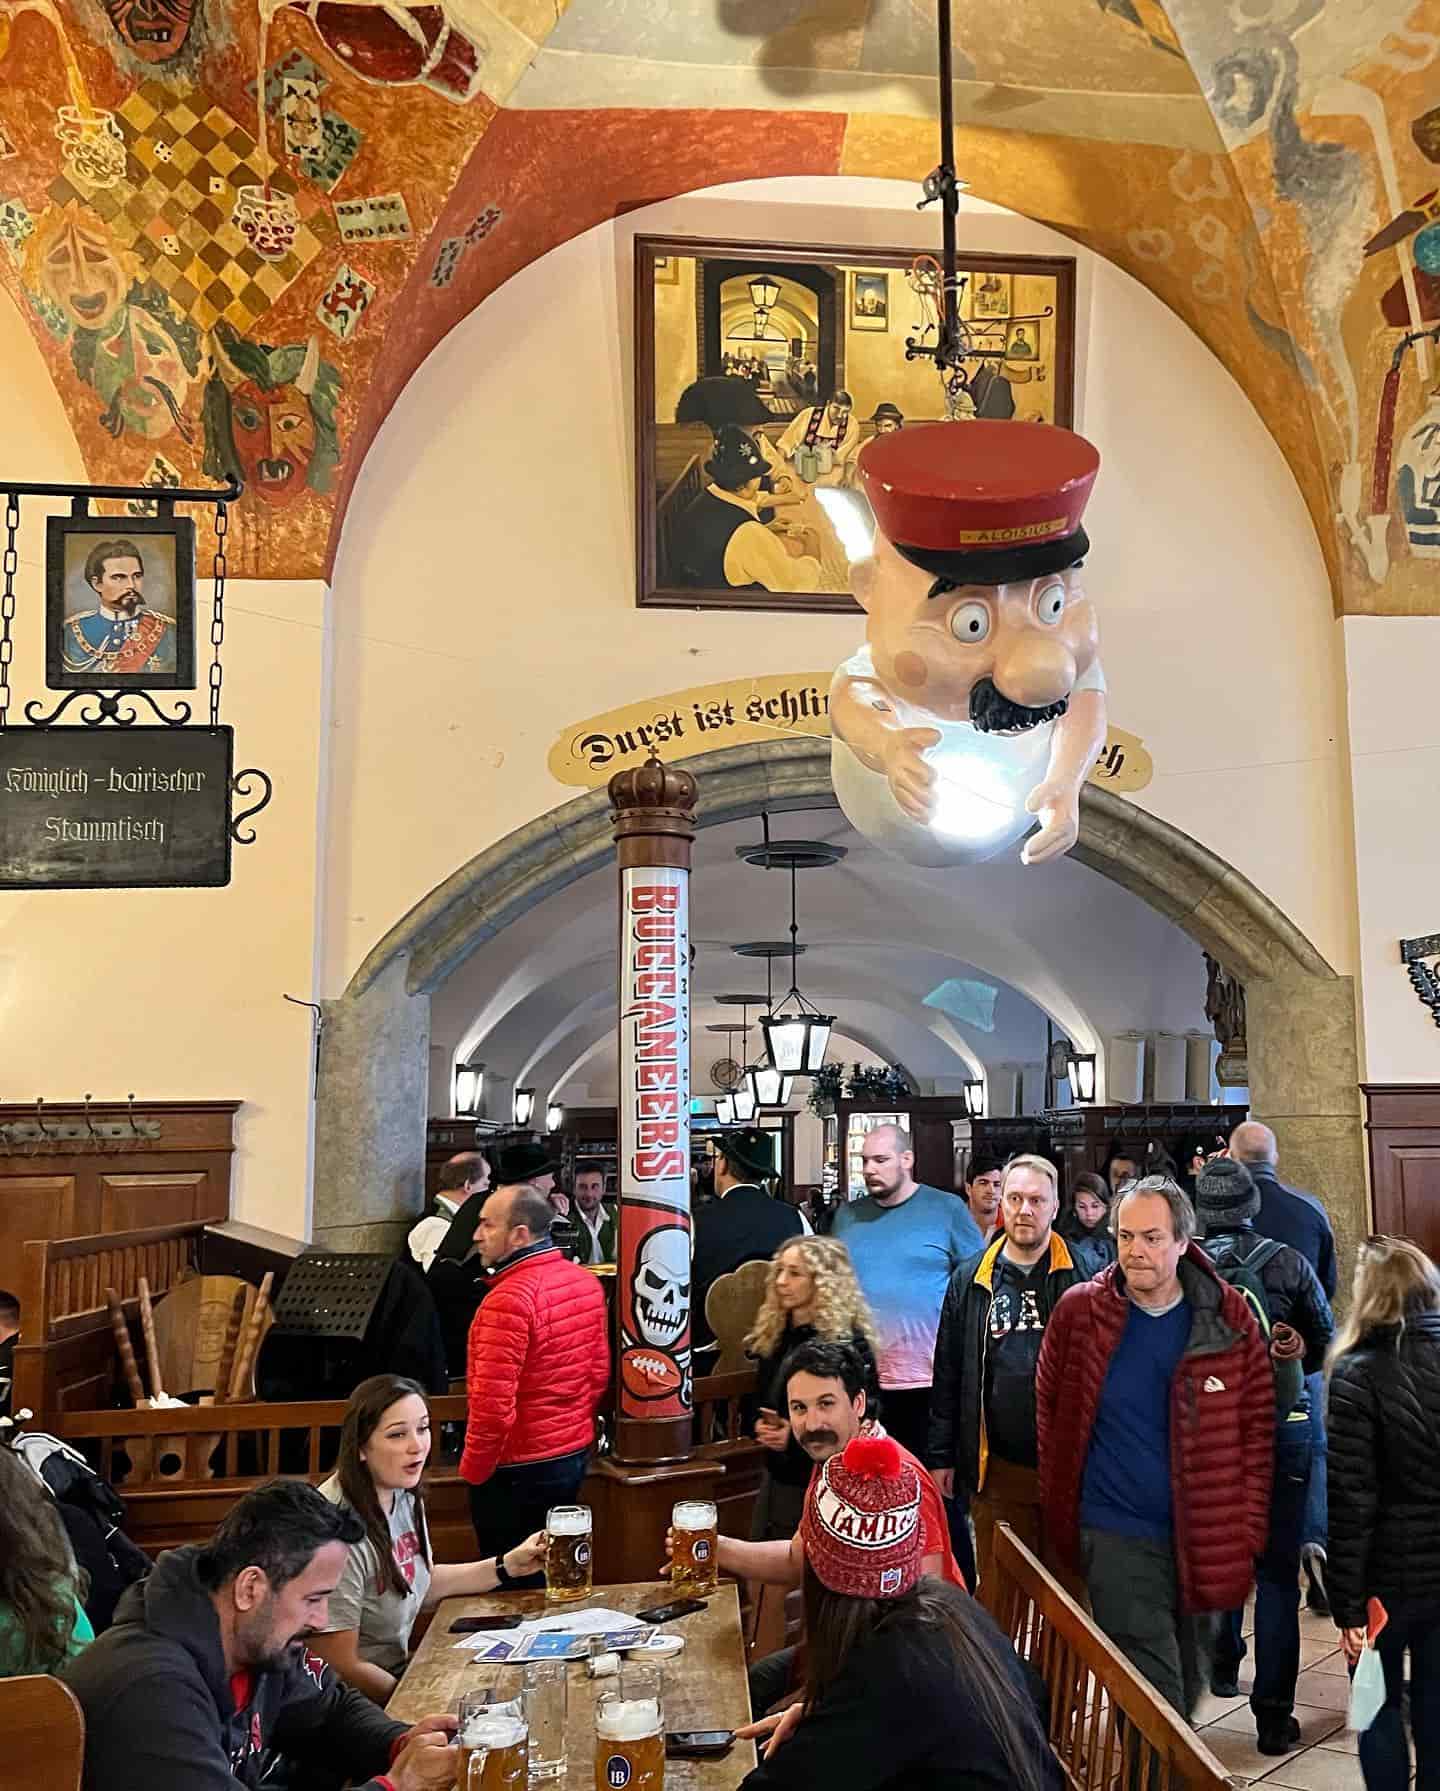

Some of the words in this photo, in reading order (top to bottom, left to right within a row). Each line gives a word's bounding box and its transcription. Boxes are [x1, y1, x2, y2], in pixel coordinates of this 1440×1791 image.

[977, 522, 1051, 541] ALOISIUS
[571, 710, 684, 770] Durst
[693, 698, 735, 732] ist
[745, 688, 829, 728] schli
[45, 816, 164, 844] Stammtisch
[624, 886, 685, 1183] BUCCANEERS
